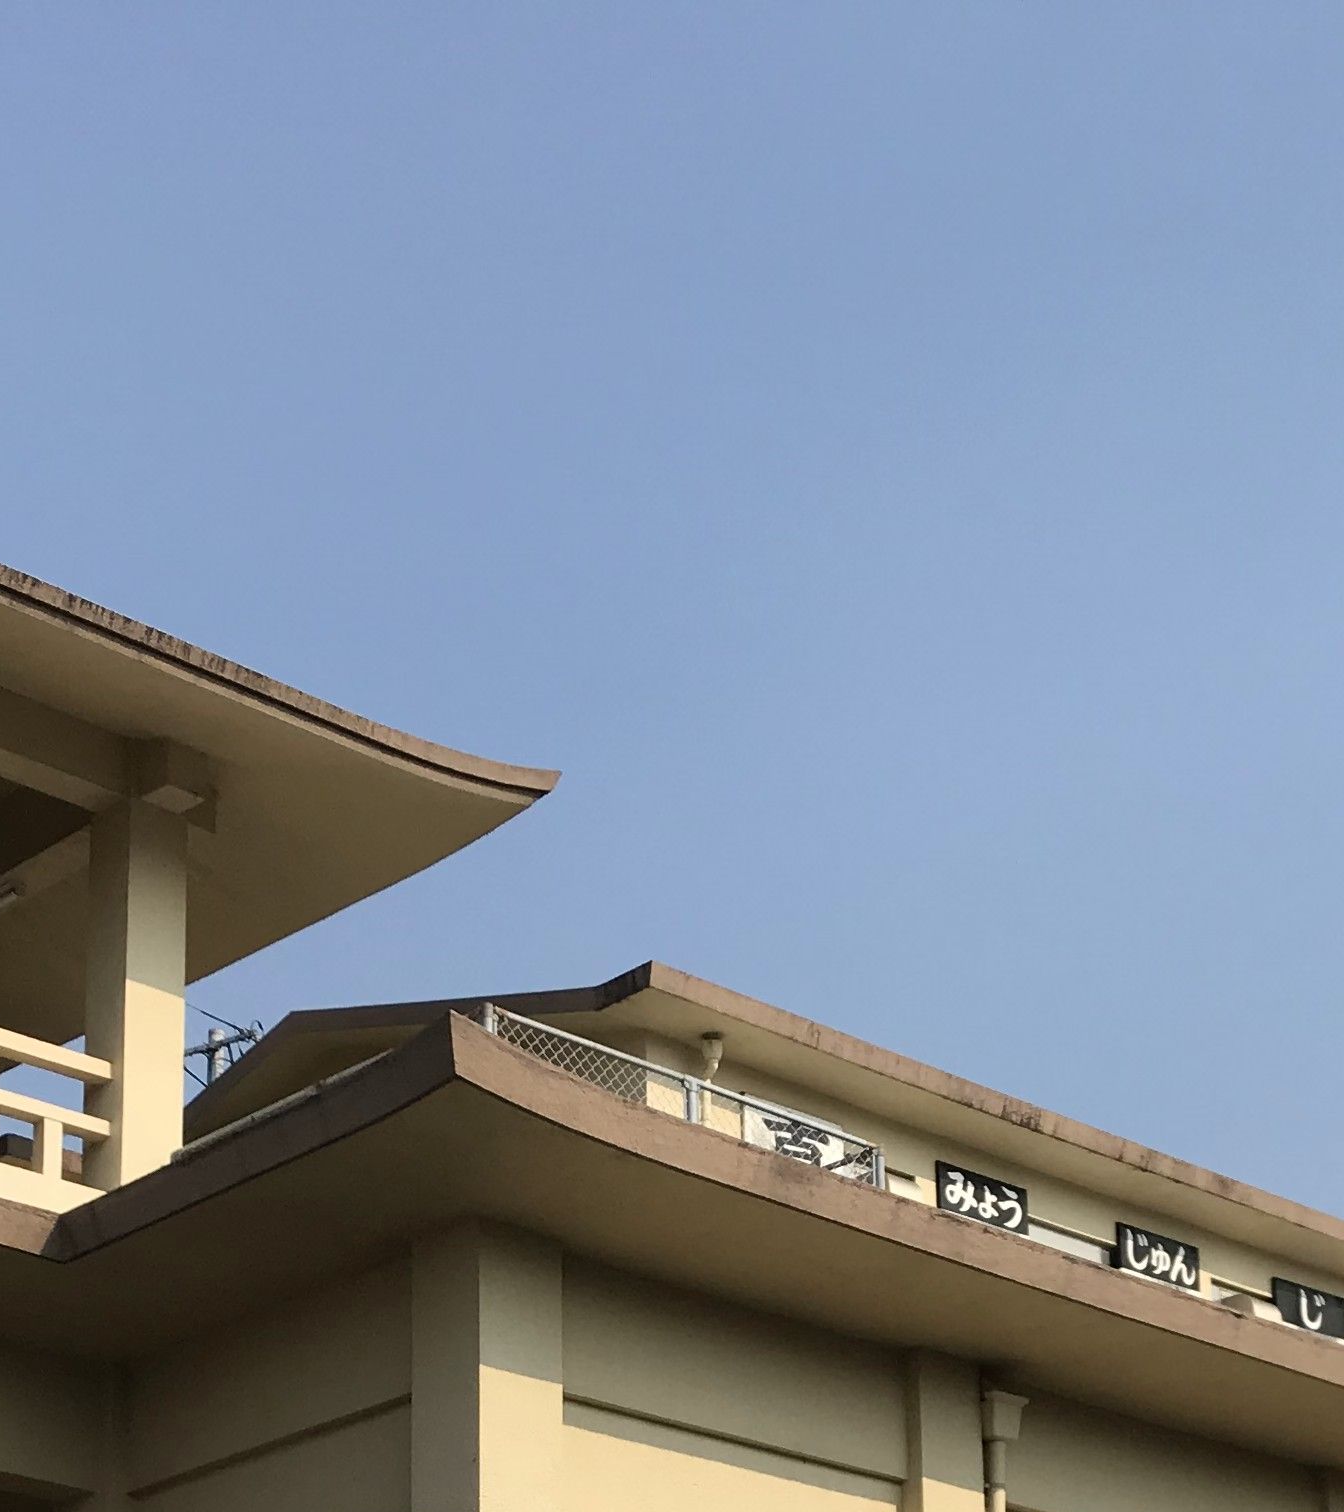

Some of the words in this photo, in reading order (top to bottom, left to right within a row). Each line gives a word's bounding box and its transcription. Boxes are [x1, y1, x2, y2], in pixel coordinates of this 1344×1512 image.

[945, 1171, 1023, 1228] みょう
[1126, 1228, 1196, 1286] じゅん
[1300, 1288, 1326, 1330] じ
